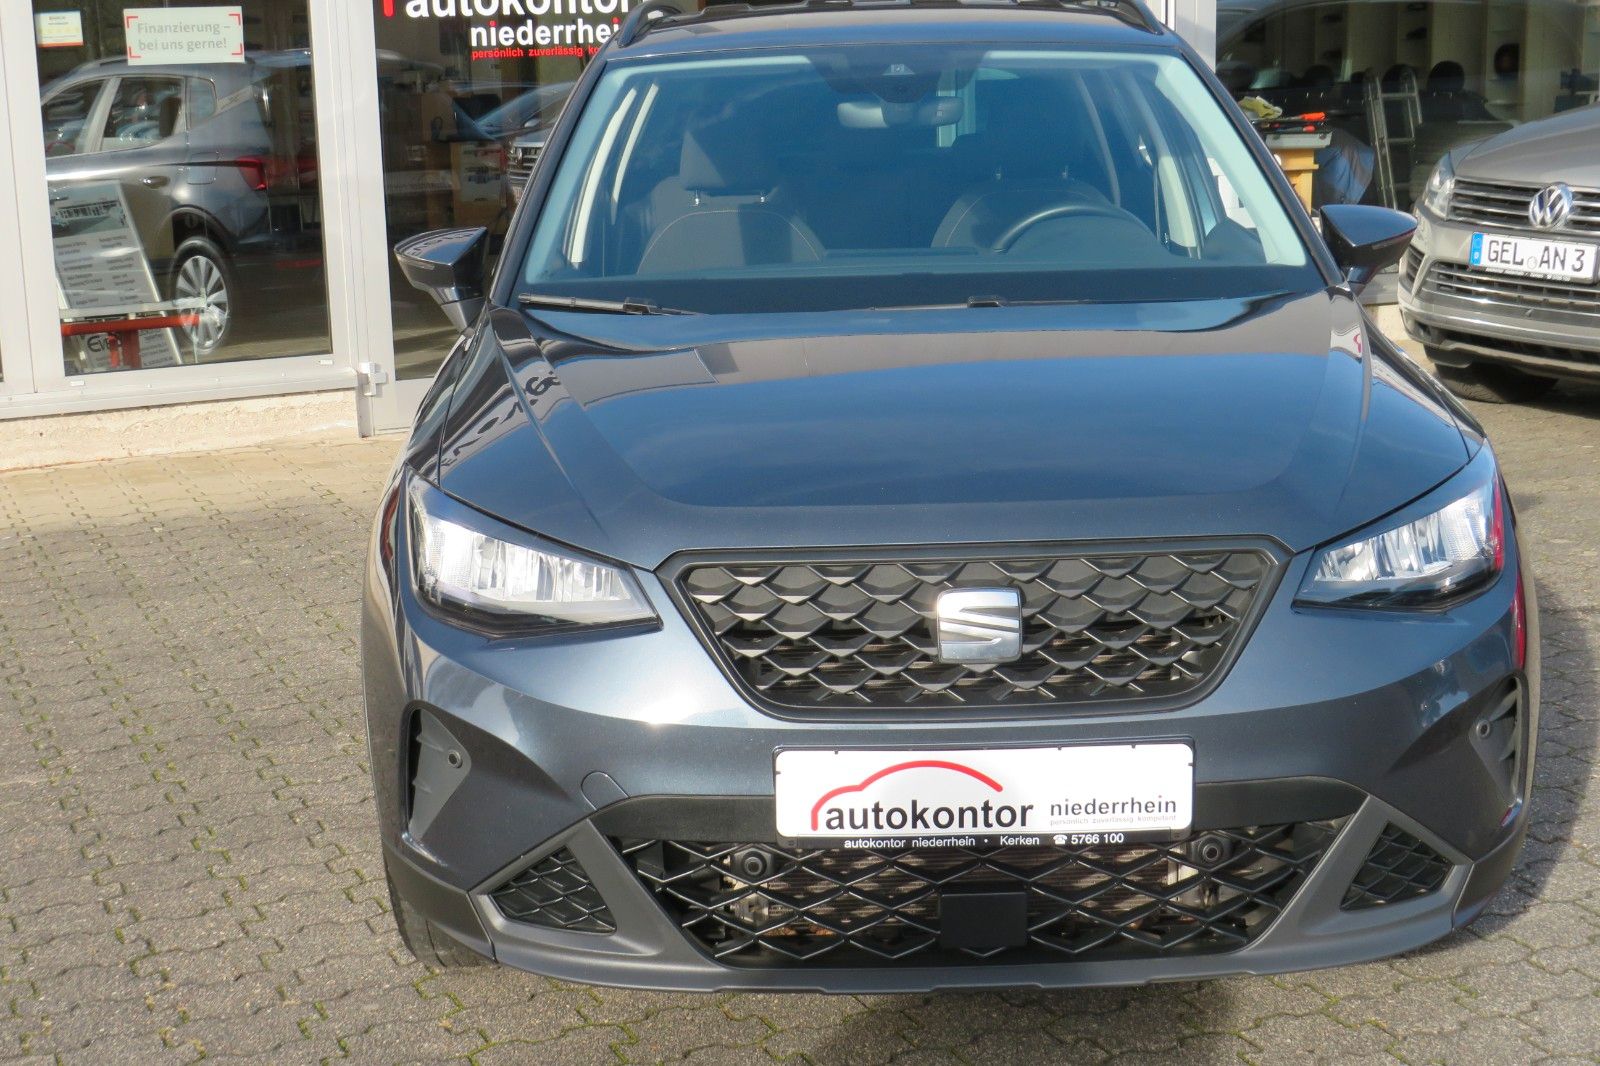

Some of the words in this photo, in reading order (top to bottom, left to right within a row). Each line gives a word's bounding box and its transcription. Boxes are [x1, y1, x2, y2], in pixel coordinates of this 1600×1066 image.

[137, 23, 221, 35] Finanzierung
[471, 17, 621, 47] niederrhei
[138, 38, 159, 51] bei
[161, 40, 186, 50] uns
[187, 36, 228, 52] gerne!
[472, 47, 524, 60] persönlich
[528, 45, 583, 58] zuverlässig
[1487, 239, 1524, 266] GEL
[1539, 245, 1567, 271] AN
[1571, 249, 1586, 272] 3
[825, 799, 1034, 830] autokontor
[1050, 795, 1177, 816] niederrhein
[844, 837, 906, 849] autokontor
[912, 836, 976, 848] niederrhein
[1000, 834, 1040, 846] Kerken
[1070, 833, 1100, 844] 5766
[1103, 833, 1124, 844] 100
